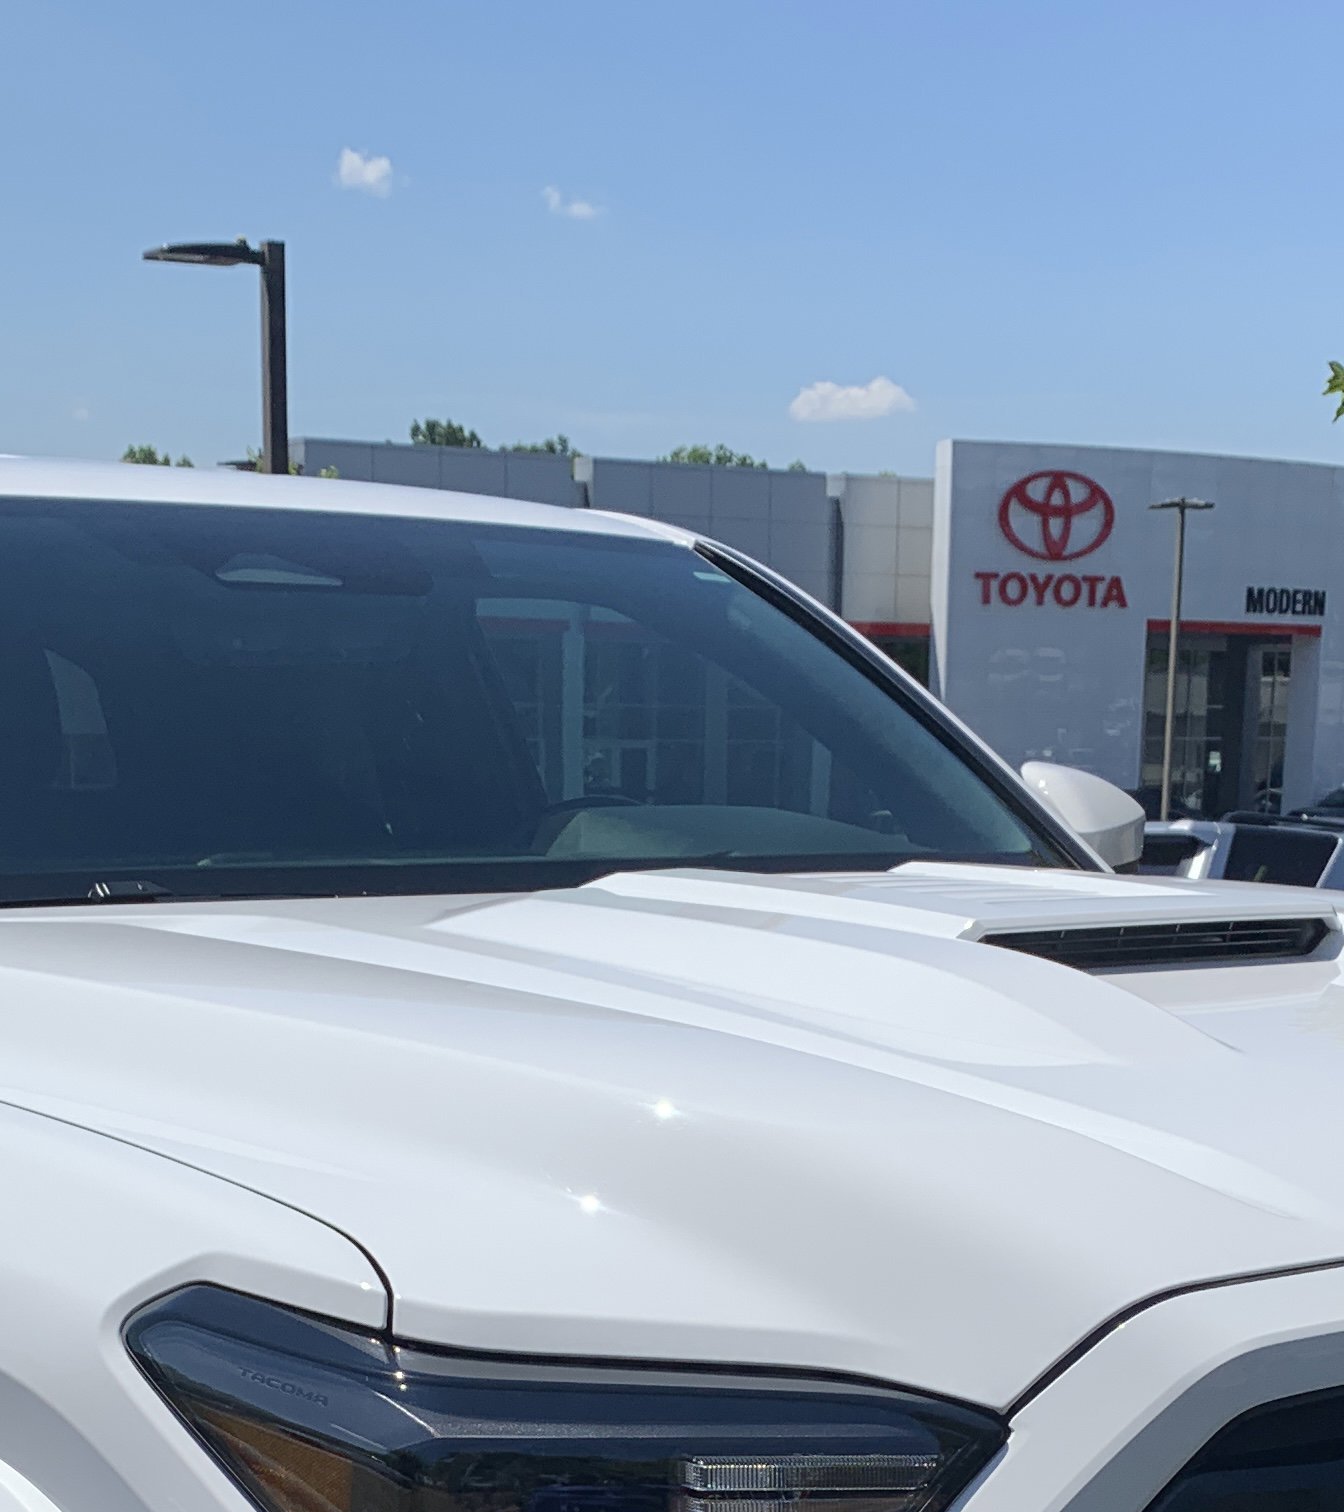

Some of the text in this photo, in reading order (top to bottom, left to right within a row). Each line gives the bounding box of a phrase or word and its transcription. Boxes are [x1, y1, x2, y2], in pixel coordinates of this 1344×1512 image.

[974, 571, 1128, 608] TOYOTA
[1246, 586, 1326, 616] MODERN
[237, 1366, 329, 1408] TACOMA
